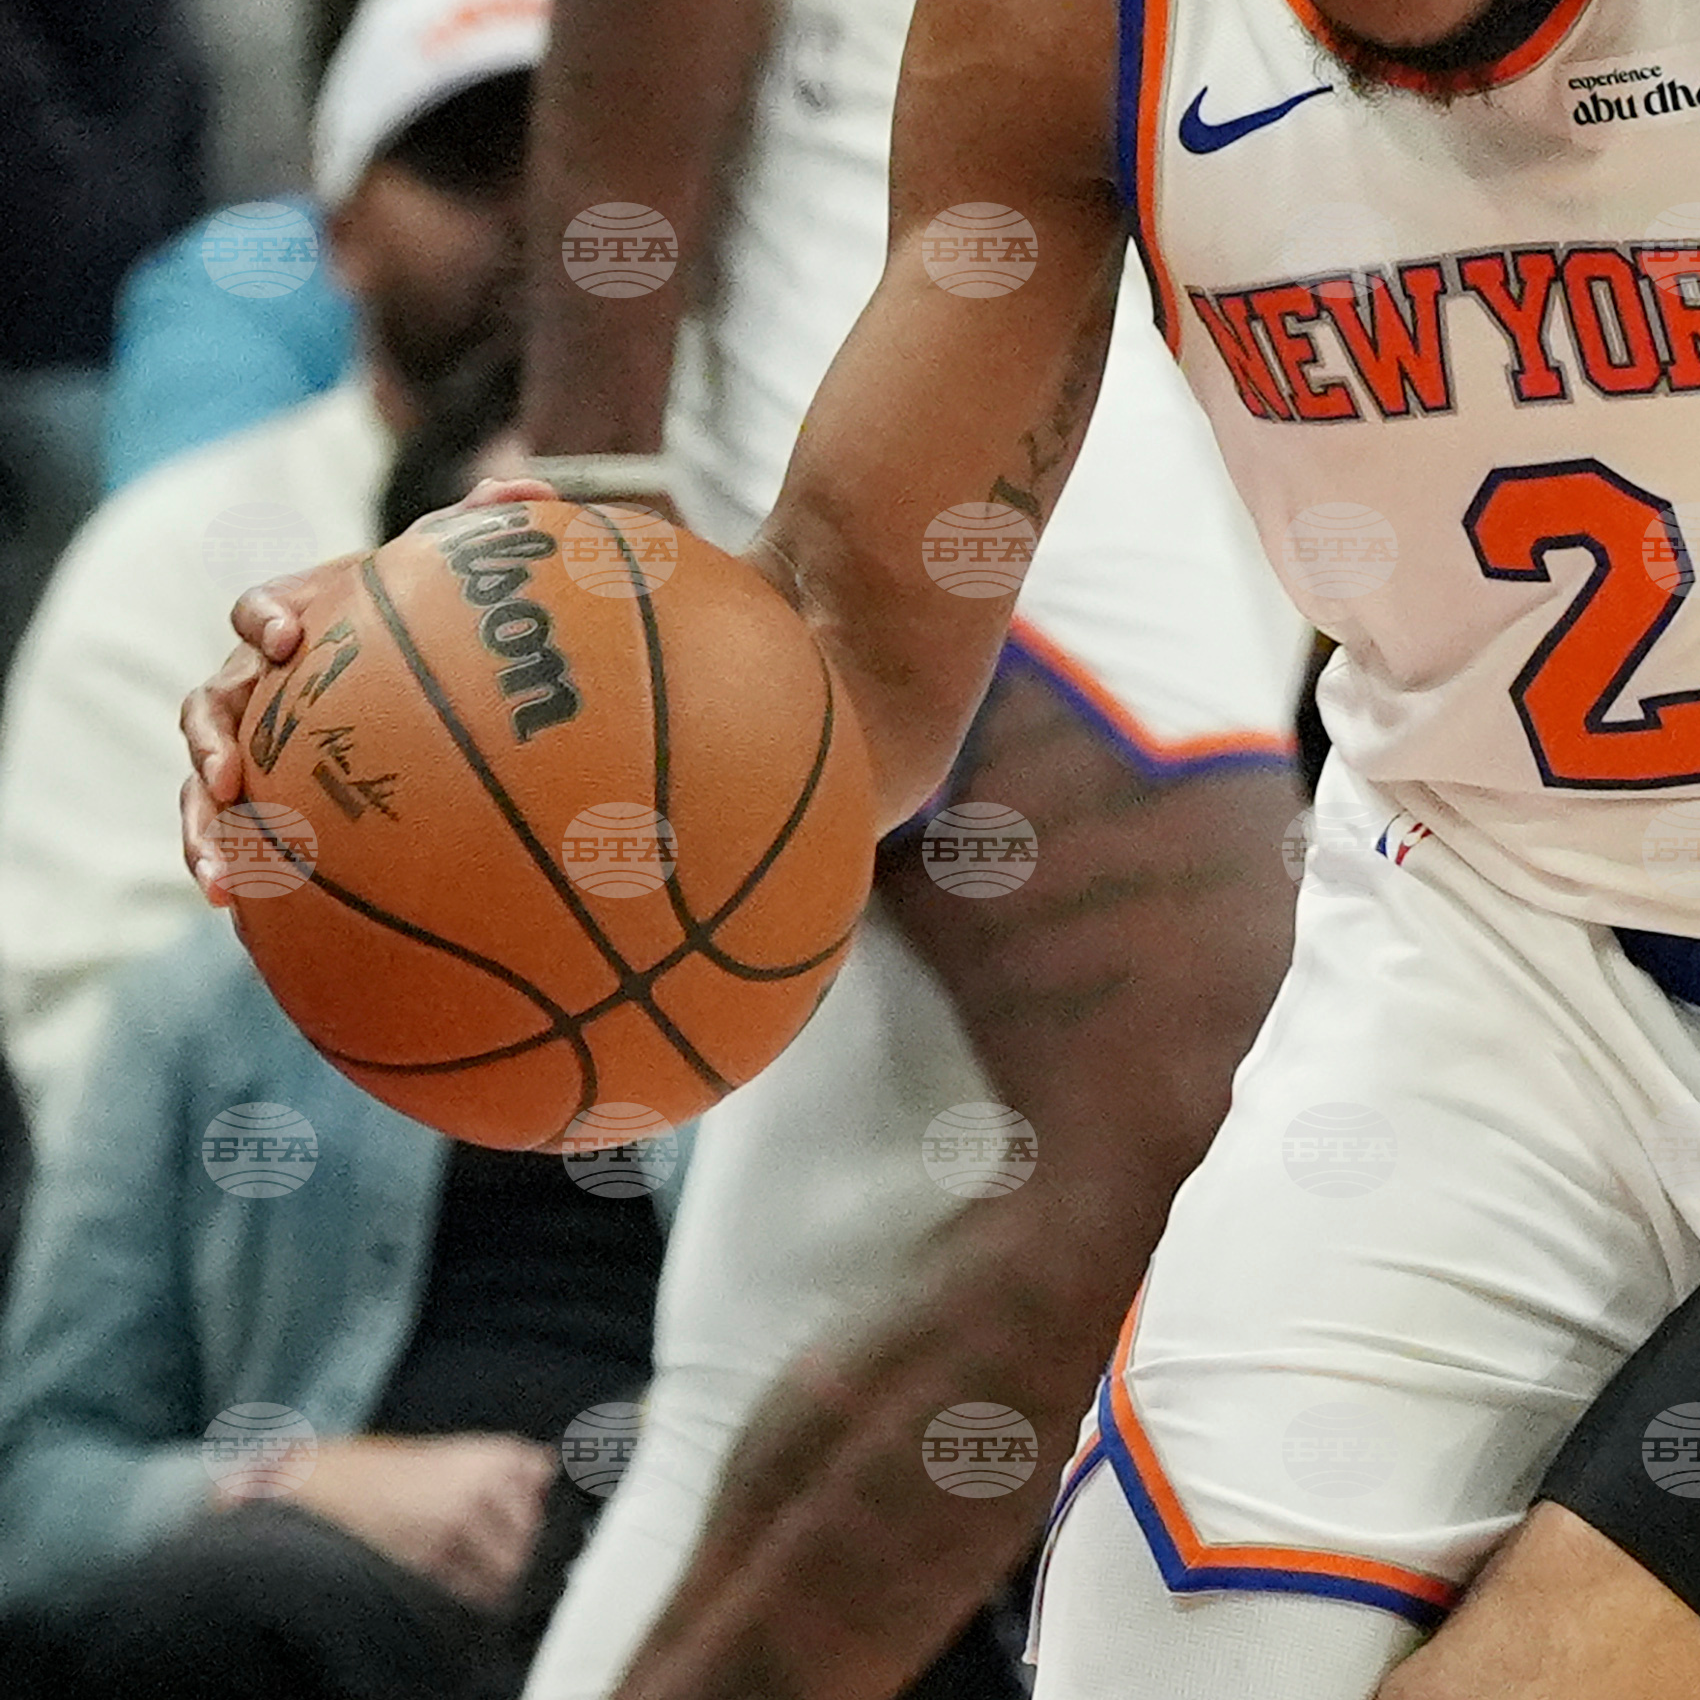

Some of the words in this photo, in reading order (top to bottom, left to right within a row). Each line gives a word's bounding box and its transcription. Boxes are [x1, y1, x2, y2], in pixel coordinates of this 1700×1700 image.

[1568, 65, 1662, 91] experience
[1573, 91, 1638, 125] abu
[1188, 259, 1458, 426] NEW
